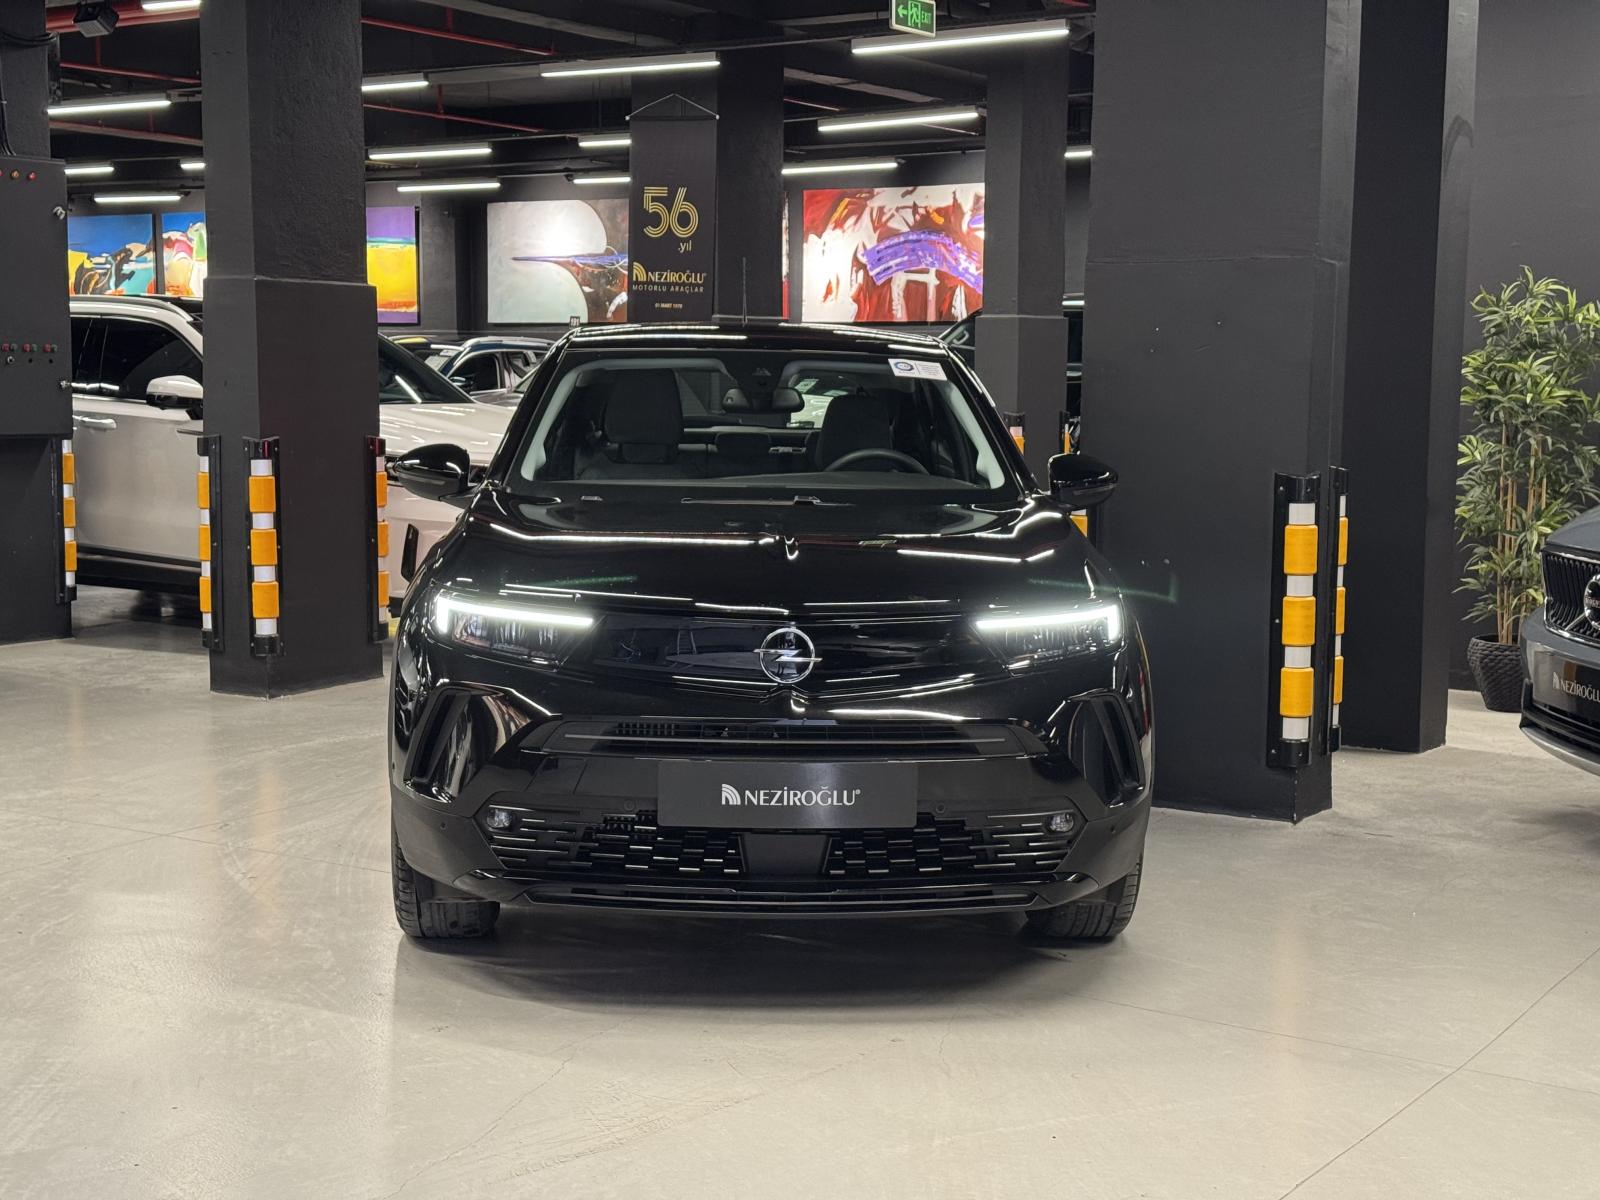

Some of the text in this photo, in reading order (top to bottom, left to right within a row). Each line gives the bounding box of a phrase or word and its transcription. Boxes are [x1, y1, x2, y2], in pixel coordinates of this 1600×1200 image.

[921, 10, 932, 25] EXIT
[643, 186, 699, 238] 56
[647, 269, 704, 284] NEZİROĞLU
[669, 285, 704, 294] ARAÇLAR
[744, 785, 857, 806] NEZİROĞLU
